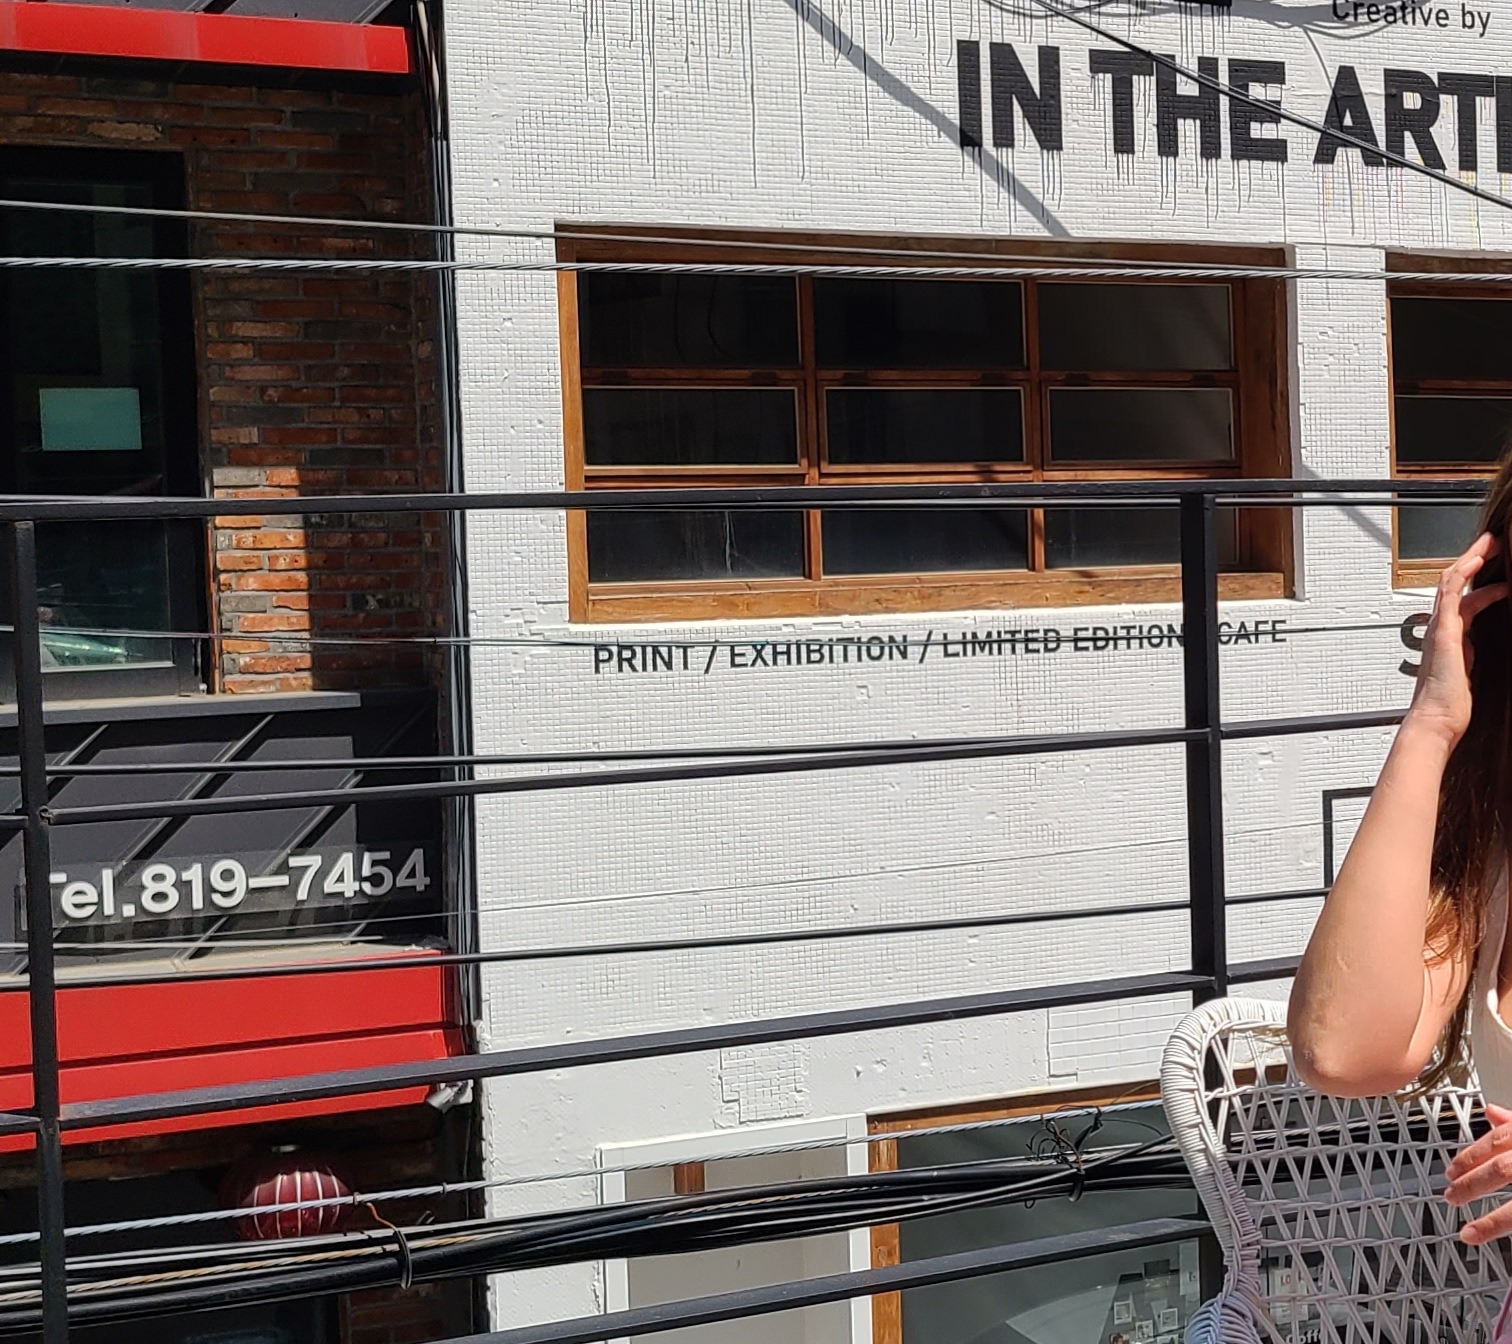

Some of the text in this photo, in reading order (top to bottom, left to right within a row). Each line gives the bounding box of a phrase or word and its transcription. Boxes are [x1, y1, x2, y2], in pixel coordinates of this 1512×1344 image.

[1461, 2, 1491, 38] by
[957, 39, 1064, 152] IN
[1090, 49, 1287, 163] THE
[593, 642, 696, 674] PRINT
[730, 634, 908, 669] EXHIBITION
[919, 629, 933, 664] /
[942, 627, 1062, 658] LIMITED
[1073, 623, 1184, 652] EDITION
[1217, 619, 1287, 646] CAFE
